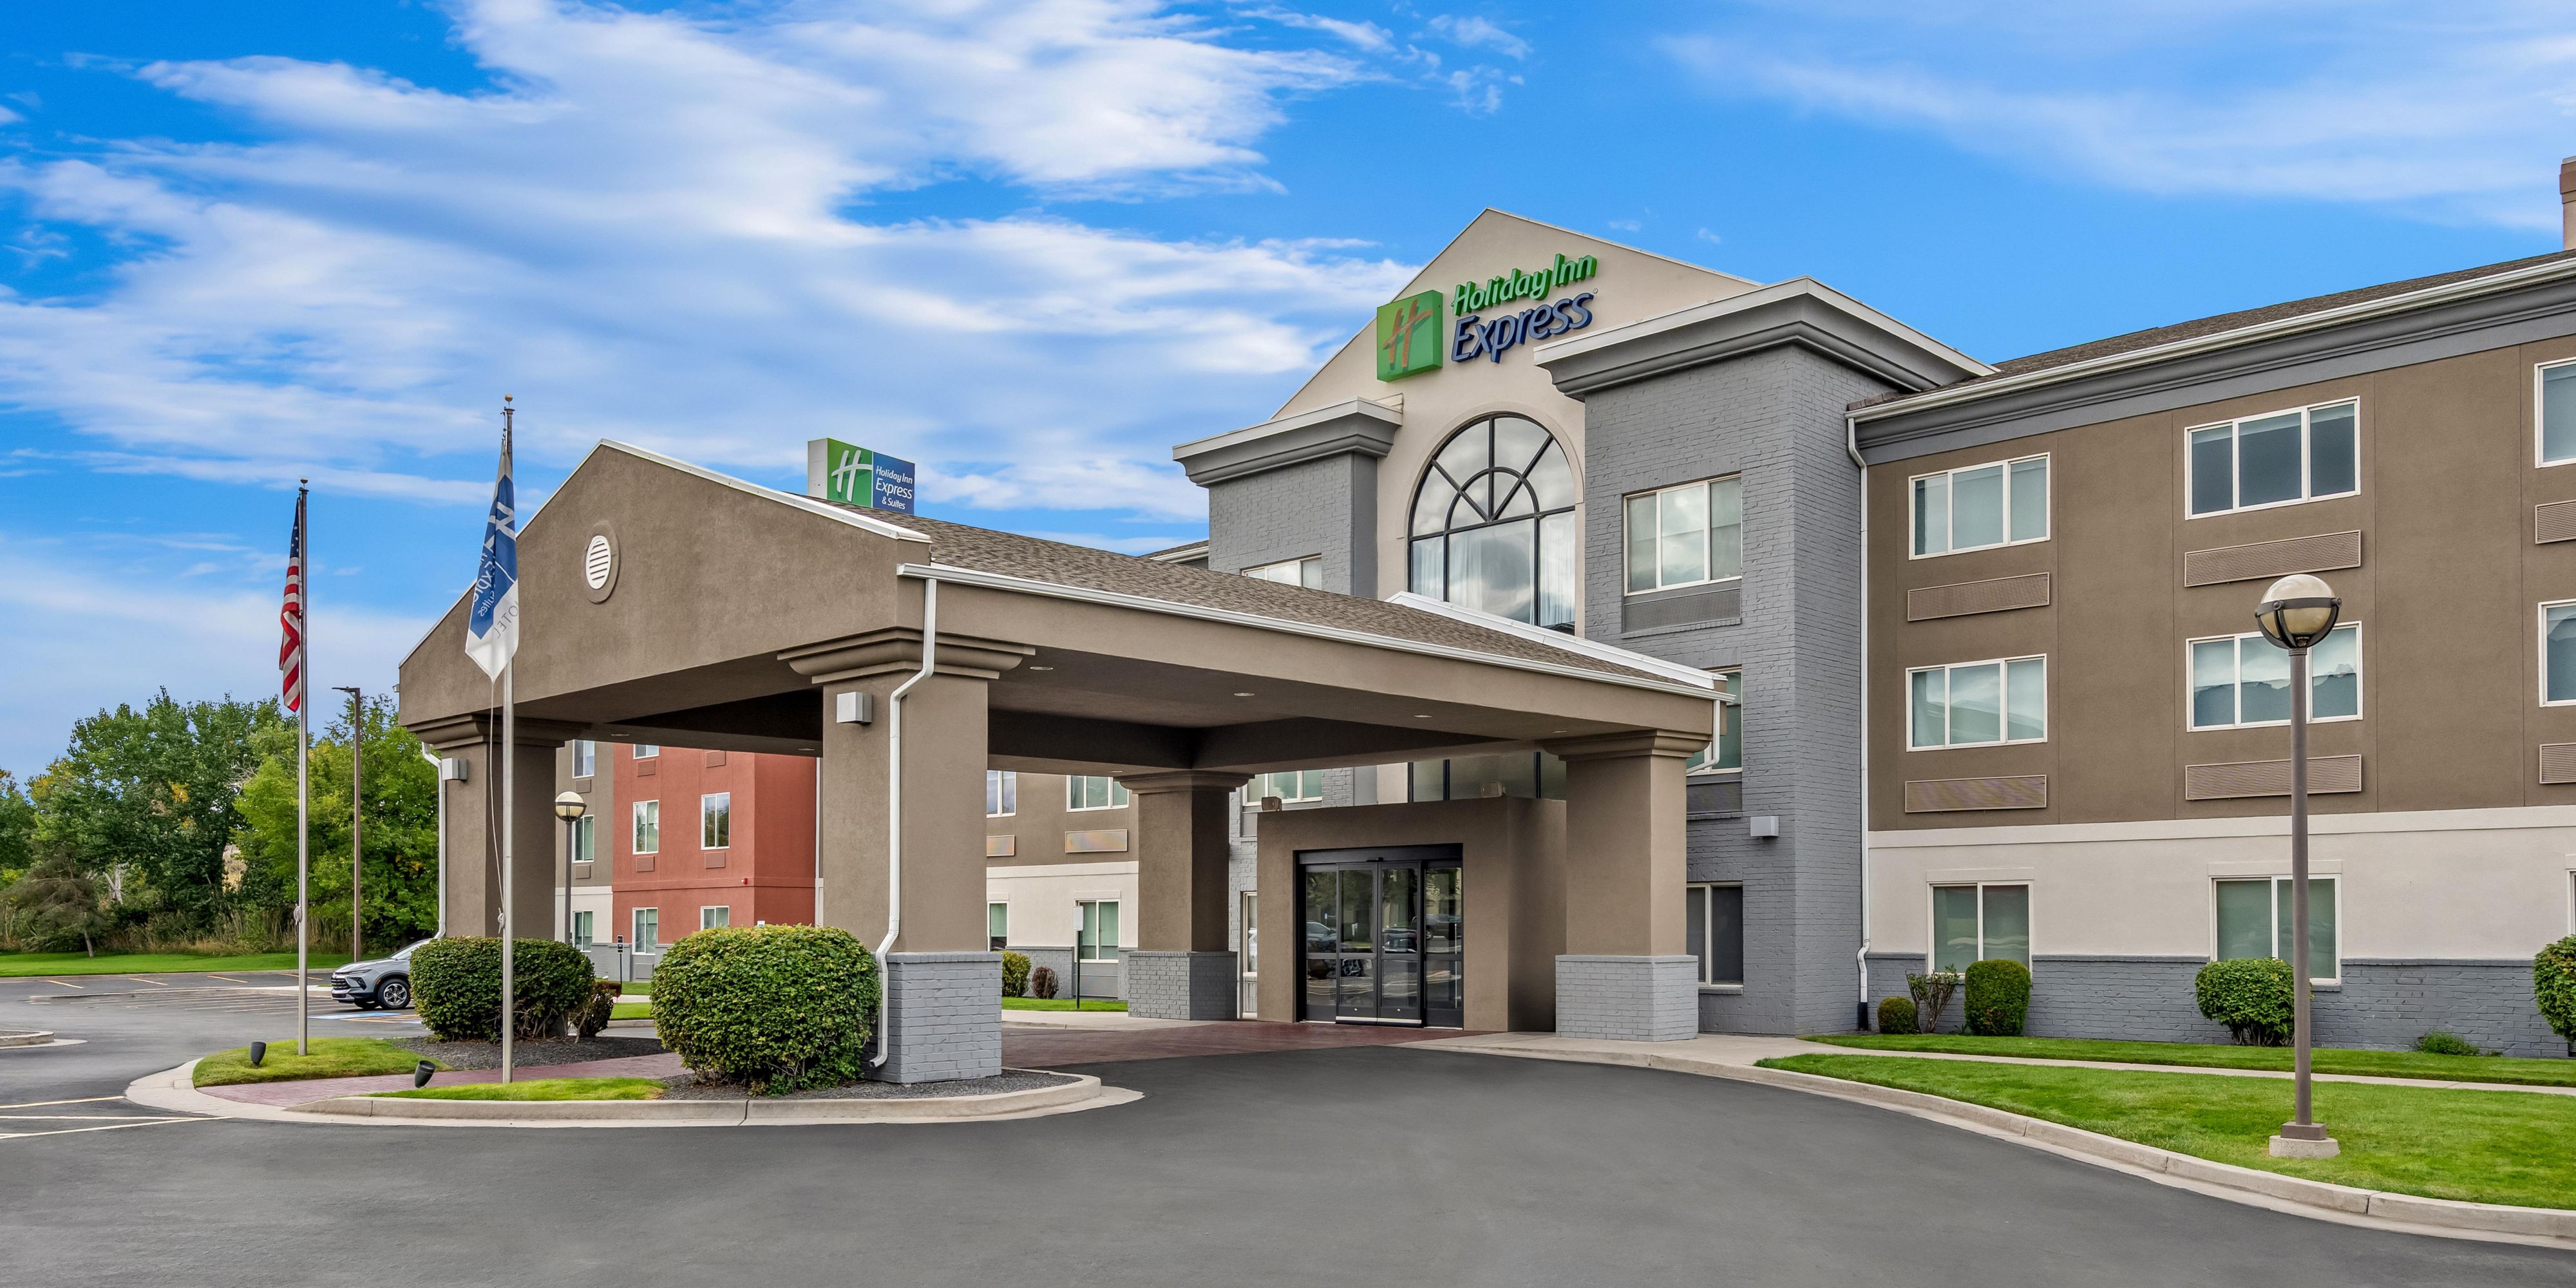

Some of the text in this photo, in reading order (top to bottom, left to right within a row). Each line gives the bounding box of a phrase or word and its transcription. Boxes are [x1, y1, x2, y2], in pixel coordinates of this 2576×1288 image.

[1451, 253, 1597, 317] Holiday Inn
[1451, 292, 1594, 364] Express
[876, 465, 913, 484] Holiday Inn
[876, 477, 913, 499] Express
[882, 496, 905, 509] & Suites
